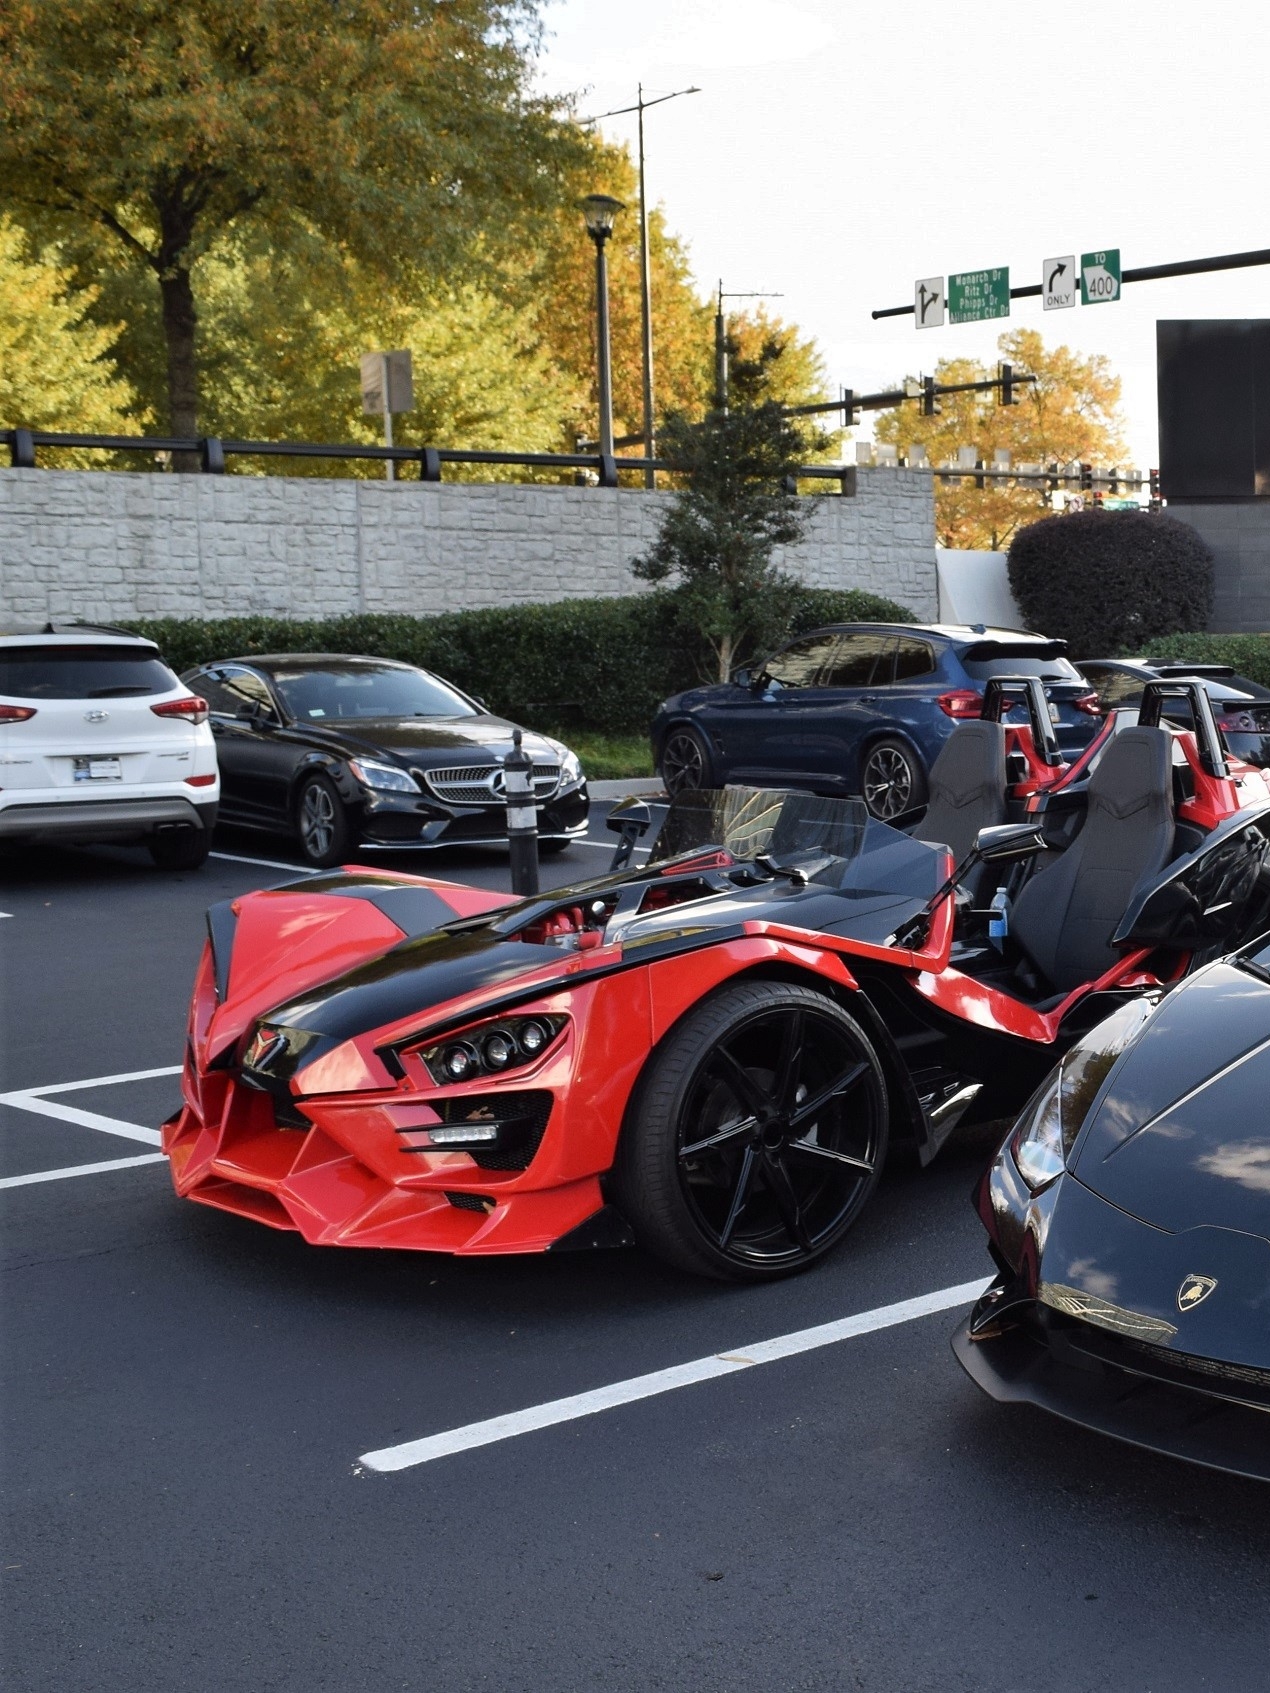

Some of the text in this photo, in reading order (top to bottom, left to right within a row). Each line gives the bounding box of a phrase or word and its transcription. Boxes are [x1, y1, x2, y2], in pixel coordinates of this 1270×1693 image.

[1094, 252, 1106, 264] TO
[955, 269, 1002, 287] Monarch Dr
[964, 283, 993, 297] Ritz Dr
[1089, 276, 1113, 297] 400
[959, 294, 999, 310] Phipps Dr
[1047, 293, 1071, 306] ONLY
[950, 304, 1009, 323] Alliance Ctr Dr
